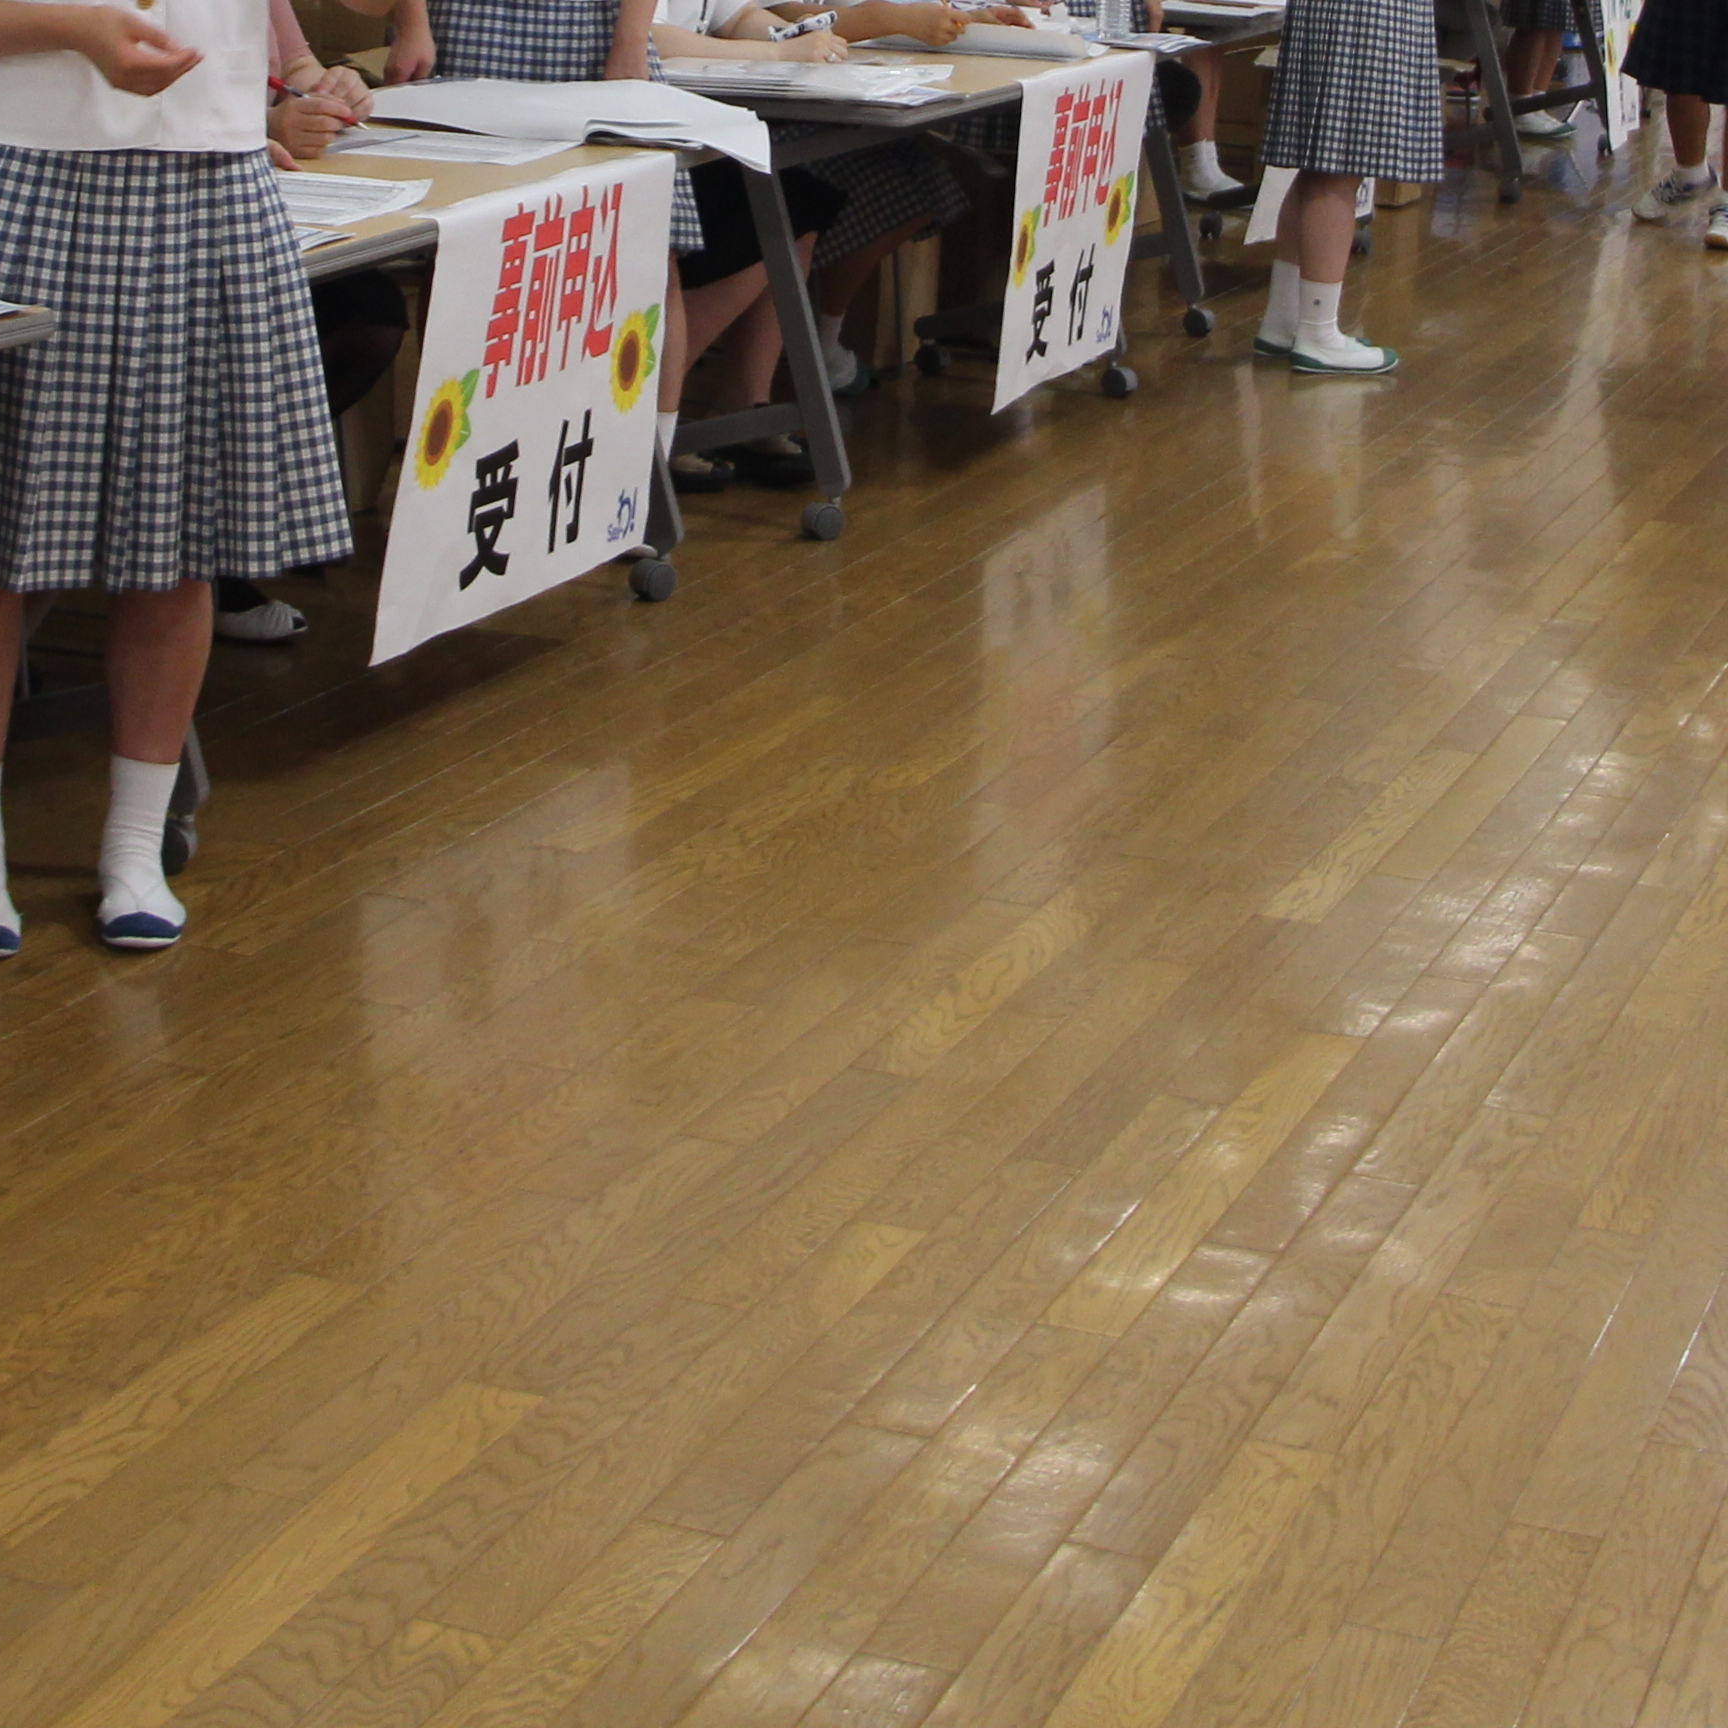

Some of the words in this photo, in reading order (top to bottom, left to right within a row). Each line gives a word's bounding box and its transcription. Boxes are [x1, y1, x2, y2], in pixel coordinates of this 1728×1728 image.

[1043, 79, 1123, 227] 事前申込
[483, 183, 623, 398] 事前申込
[1026, 243, 1096, 365] 受付
[459, 409, 593, 591] 受付
